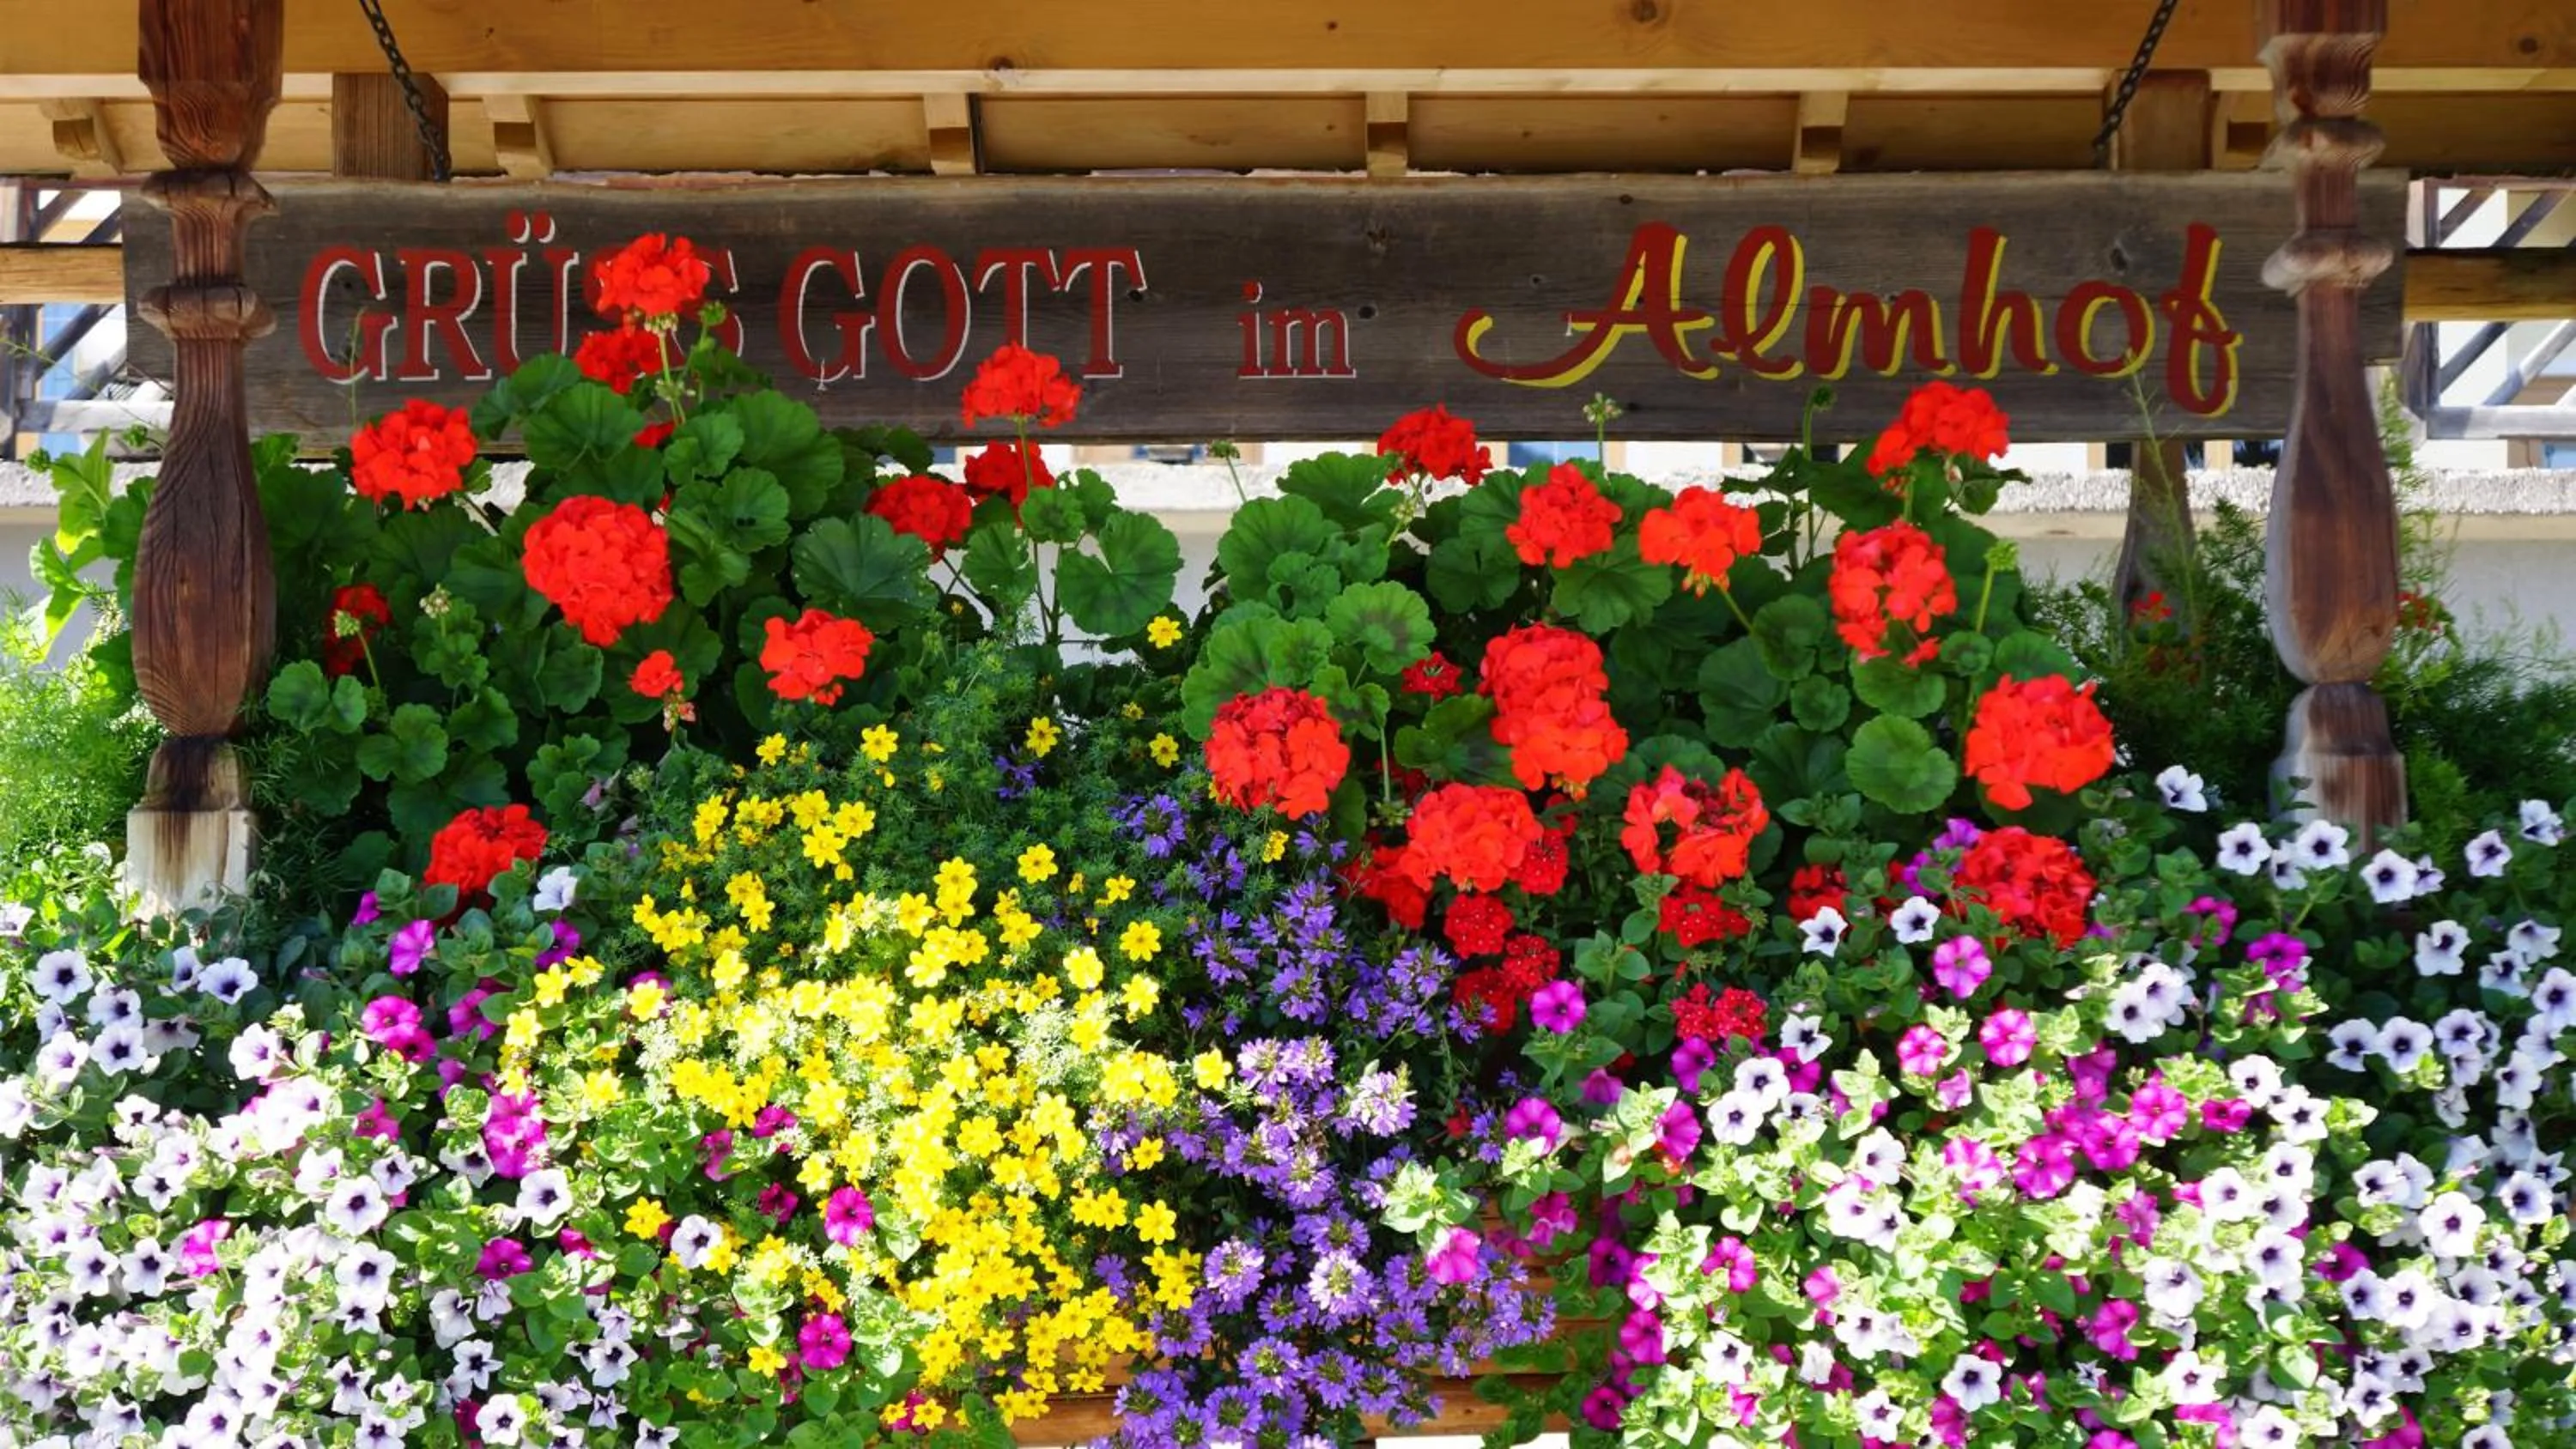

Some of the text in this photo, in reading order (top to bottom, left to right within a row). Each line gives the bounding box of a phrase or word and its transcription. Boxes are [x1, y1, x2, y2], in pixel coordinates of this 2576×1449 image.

[298, 209, 2243, 418] GRÜS GOTT im Almhof
